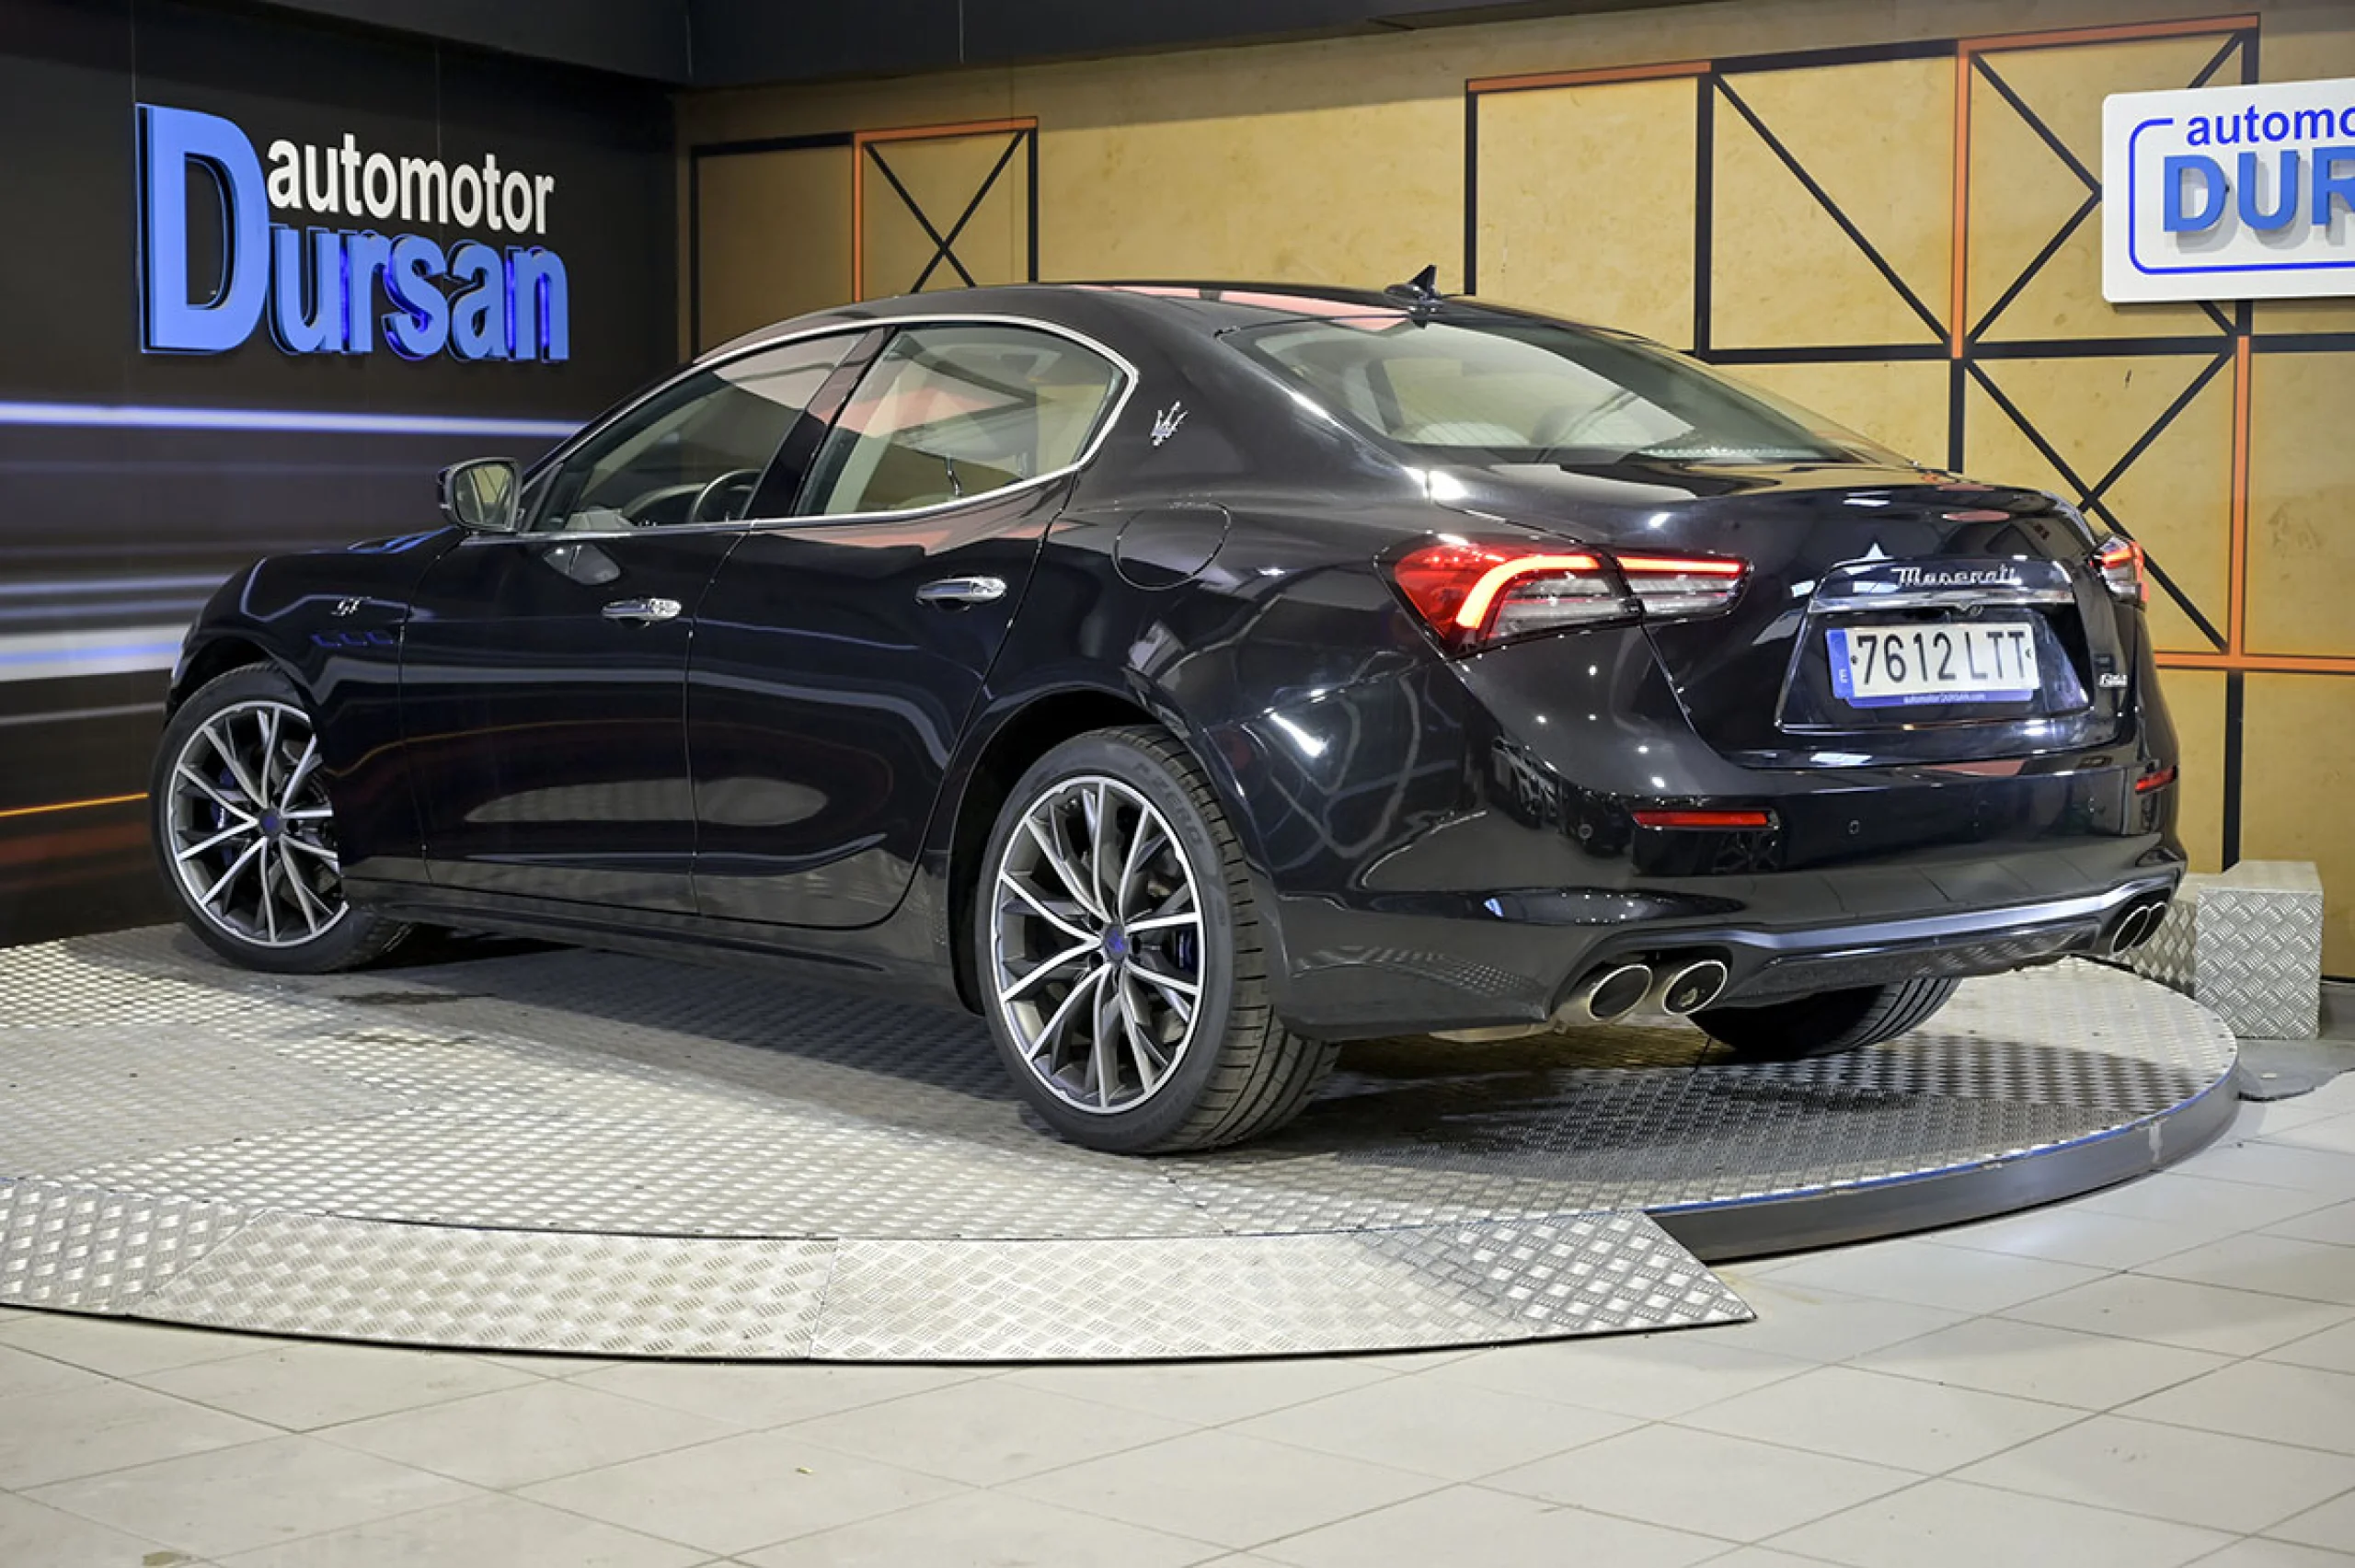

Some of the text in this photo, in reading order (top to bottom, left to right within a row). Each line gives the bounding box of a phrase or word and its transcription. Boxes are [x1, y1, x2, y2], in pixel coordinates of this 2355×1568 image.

[267, 132, 555, 234] automotor
[2164, 147, 2355, 233] DUR
[135, 102, 569, 362] Dursan
[1890, 563, 2022, 587] Maserati
[1839, 669, 1848, 683] E
[1856, 631, 2026, 685] 7612 LTT
